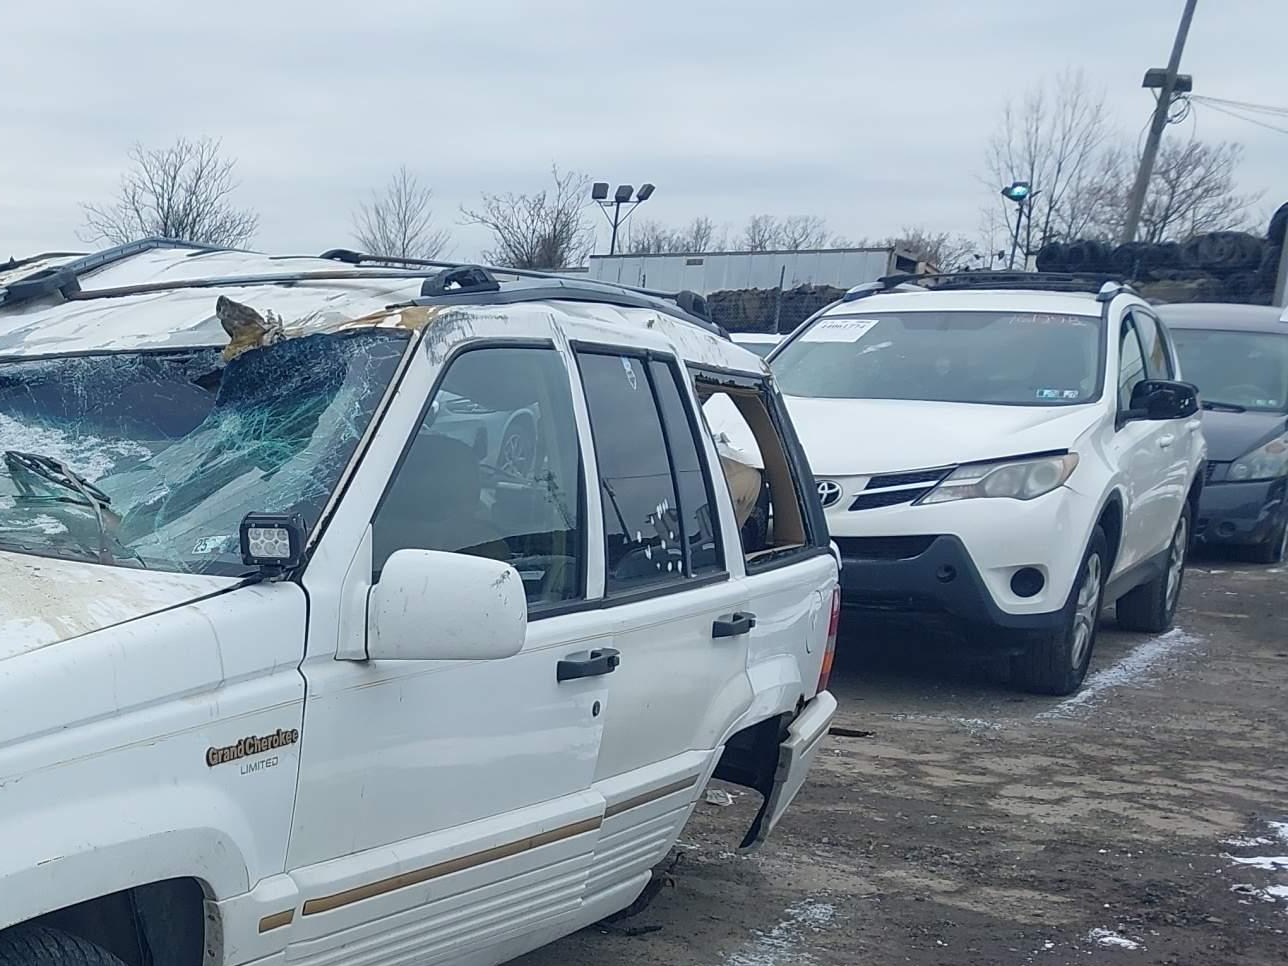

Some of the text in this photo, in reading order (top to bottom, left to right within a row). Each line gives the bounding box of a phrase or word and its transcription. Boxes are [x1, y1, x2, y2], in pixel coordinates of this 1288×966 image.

[206, 728, 299, 767] Grand Cherokee
[240, 756, 279, 775] LIMITED
